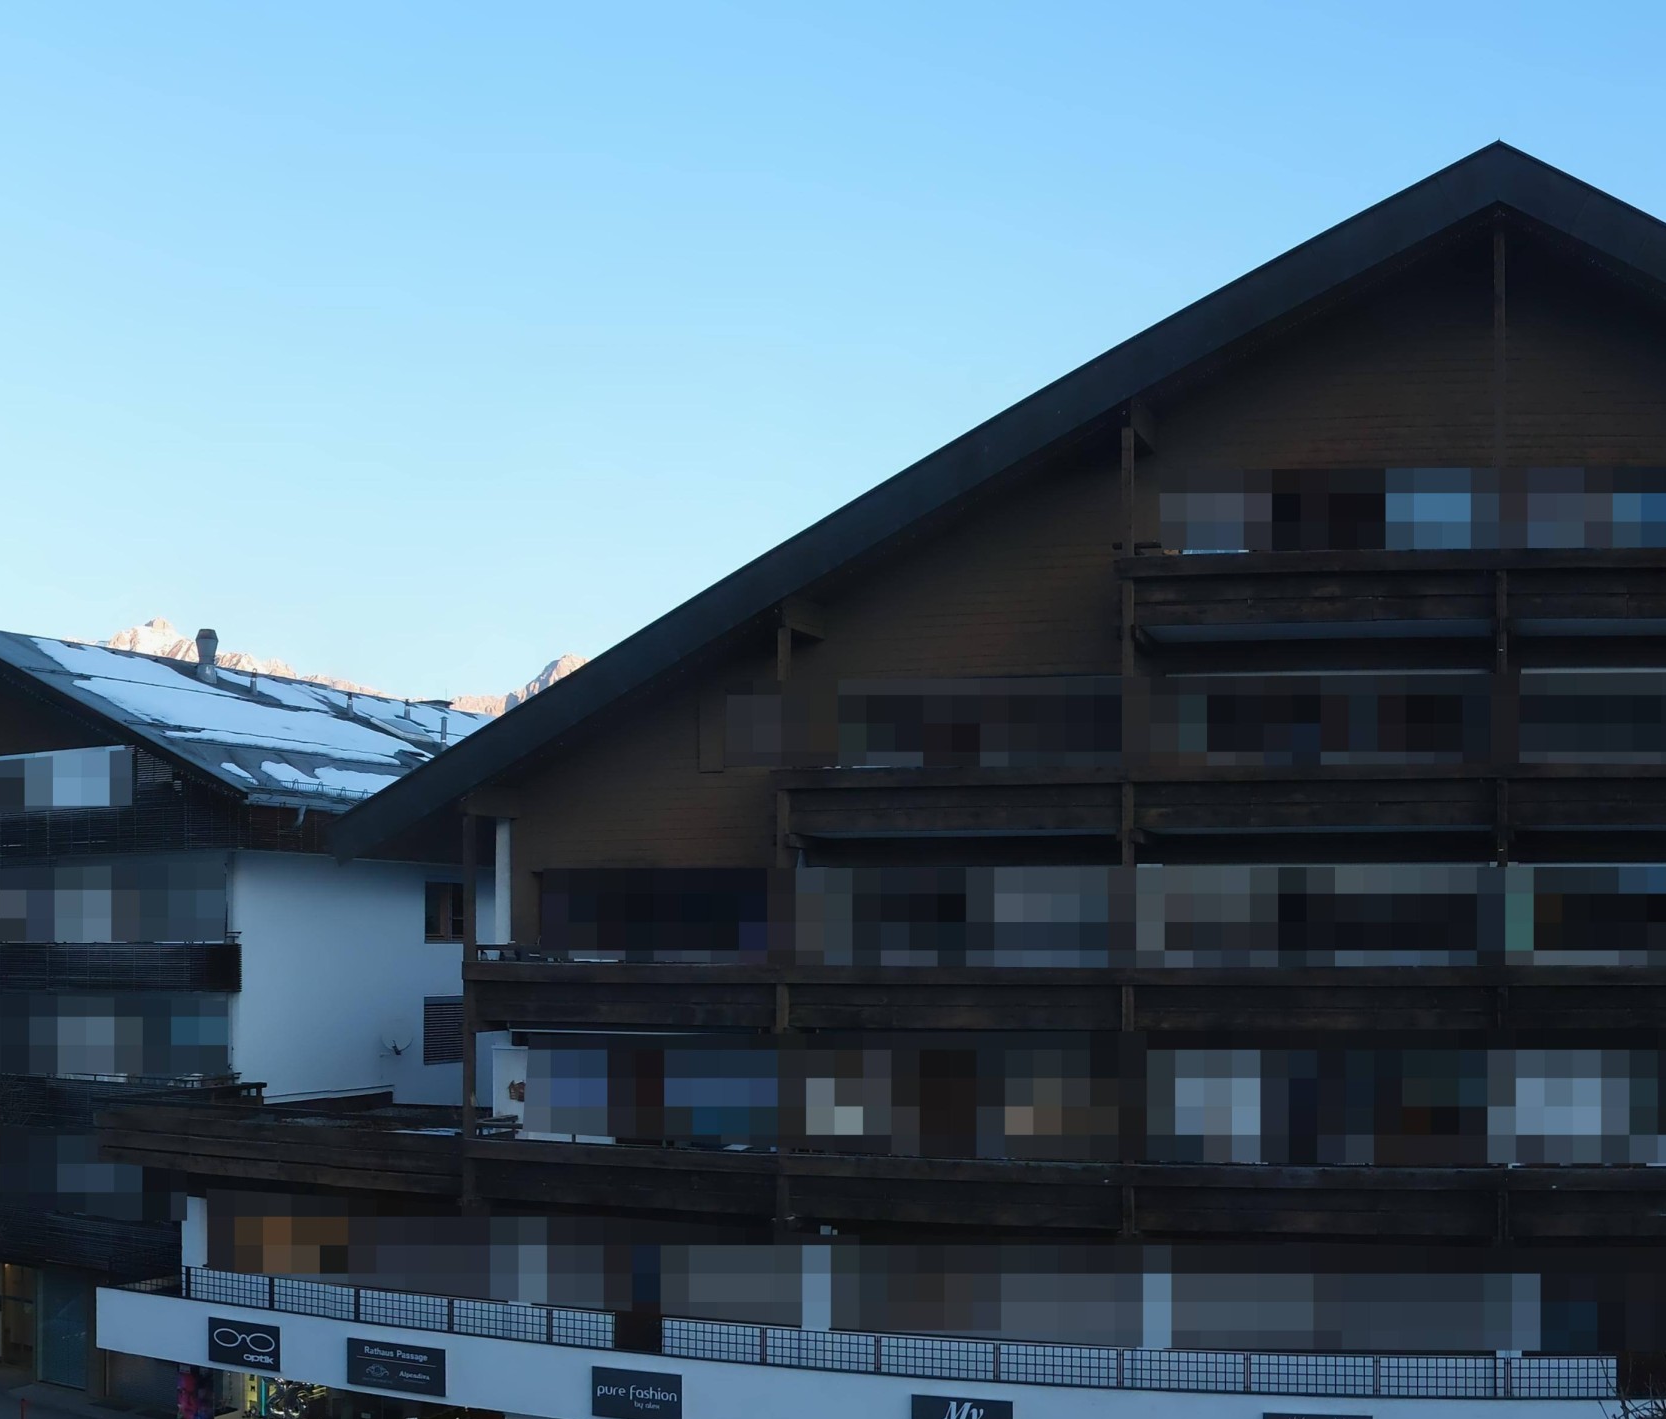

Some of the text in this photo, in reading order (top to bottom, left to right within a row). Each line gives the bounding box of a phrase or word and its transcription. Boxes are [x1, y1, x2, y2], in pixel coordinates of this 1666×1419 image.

[243, 1353, 275, 1365] optik
[364, 1346, 428, 1362] Rathaus Passage
[596, 1384, 677, 1402] pure fashion
[634, 1400, 660, 1410] by alex
